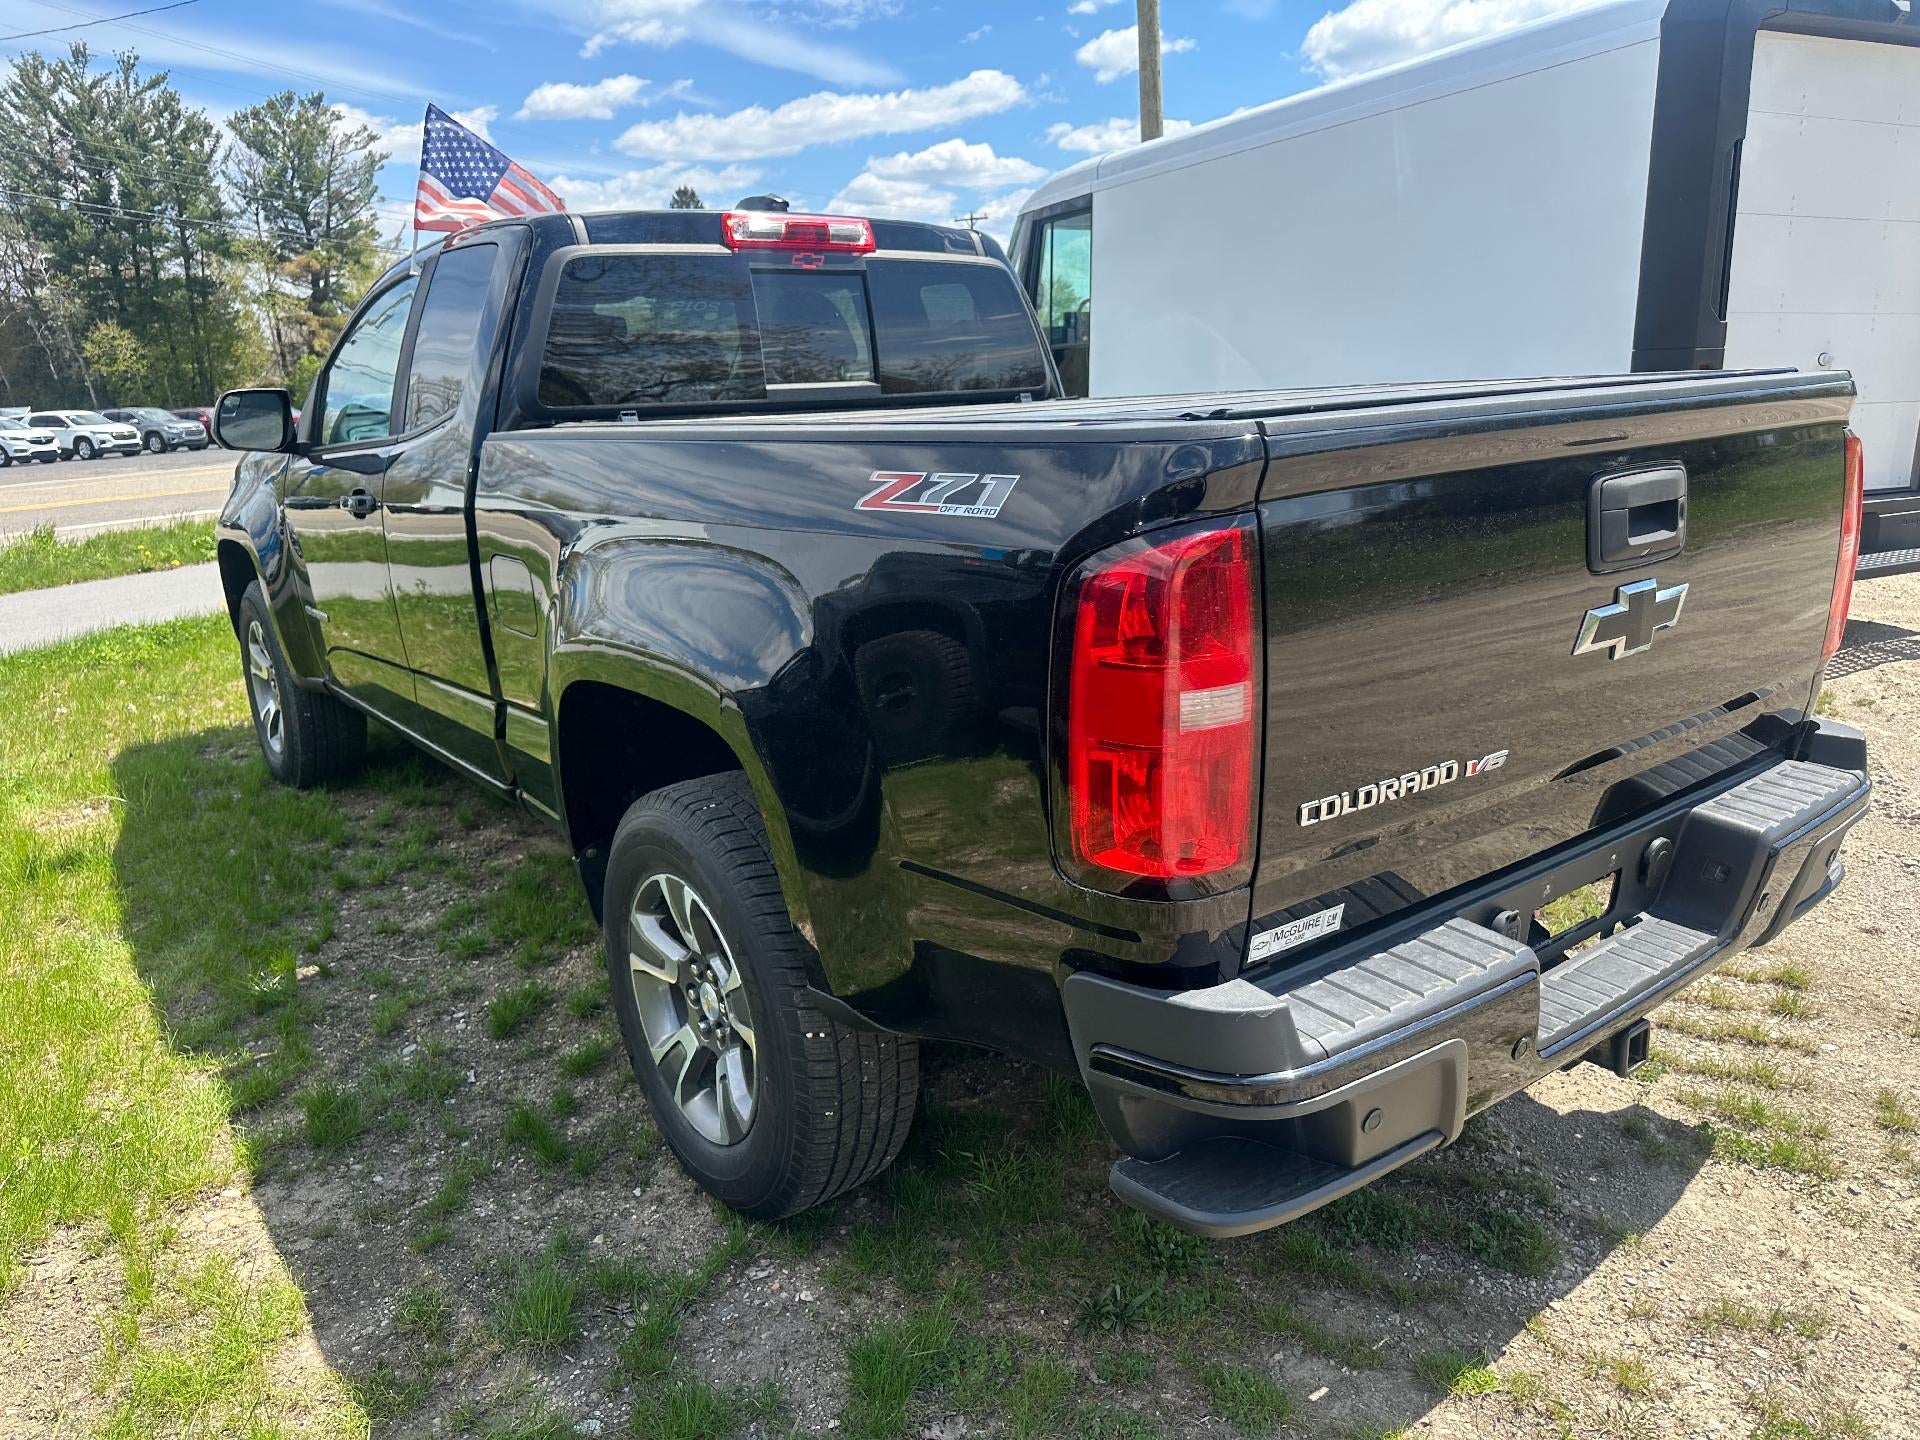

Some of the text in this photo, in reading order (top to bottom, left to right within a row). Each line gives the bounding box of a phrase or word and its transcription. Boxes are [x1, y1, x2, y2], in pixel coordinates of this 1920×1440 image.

[853, 470, 1021, 510] Z71
[939, 505, 998, 516] OFF ROAD
[1297, 749, 1509, 827] COLORADO V6
[1273, 916, 1321, 943] McGUIRE
